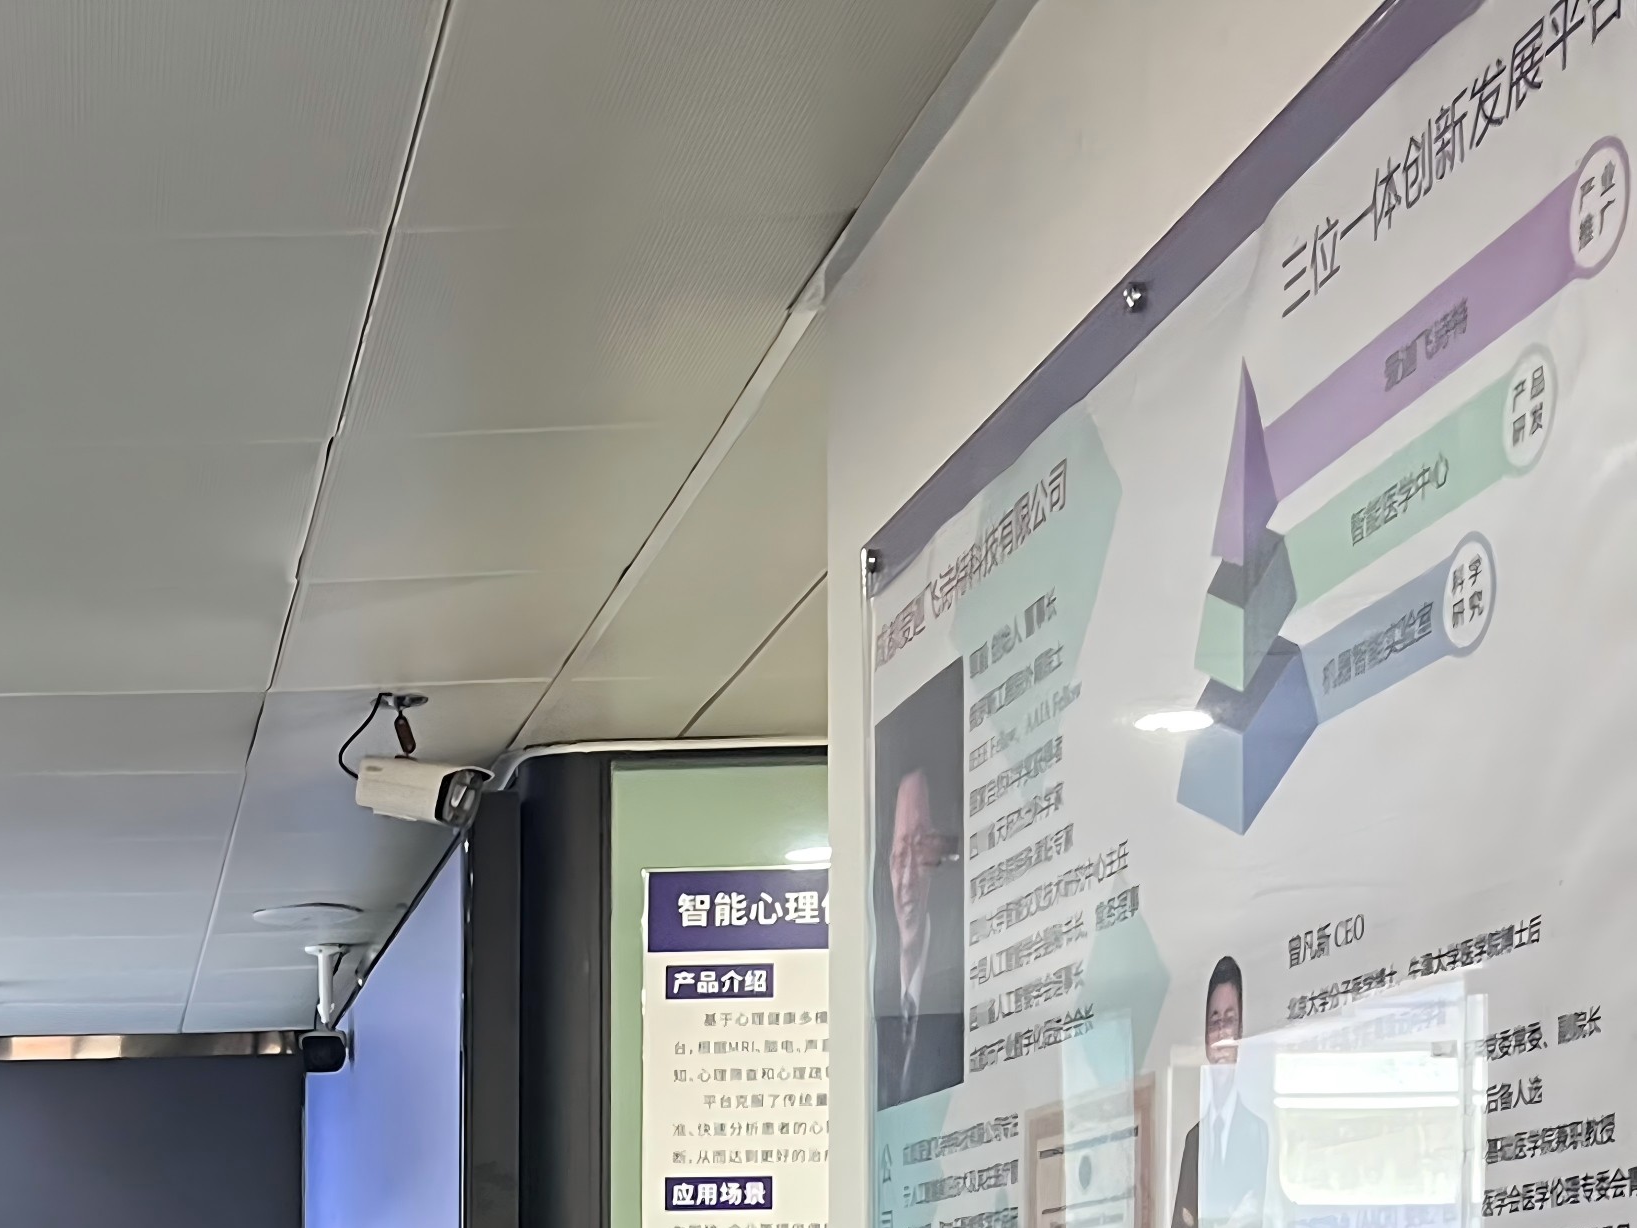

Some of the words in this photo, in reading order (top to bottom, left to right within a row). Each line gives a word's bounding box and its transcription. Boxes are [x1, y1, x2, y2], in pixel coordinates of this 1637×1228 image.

[677, 890, 830, 928] 智能心理
[1335, 914, 1365, 948] CEO
[673, 970, 767, 994] 产品介绍
[672, 1181, 766, 1206] 应用场景
